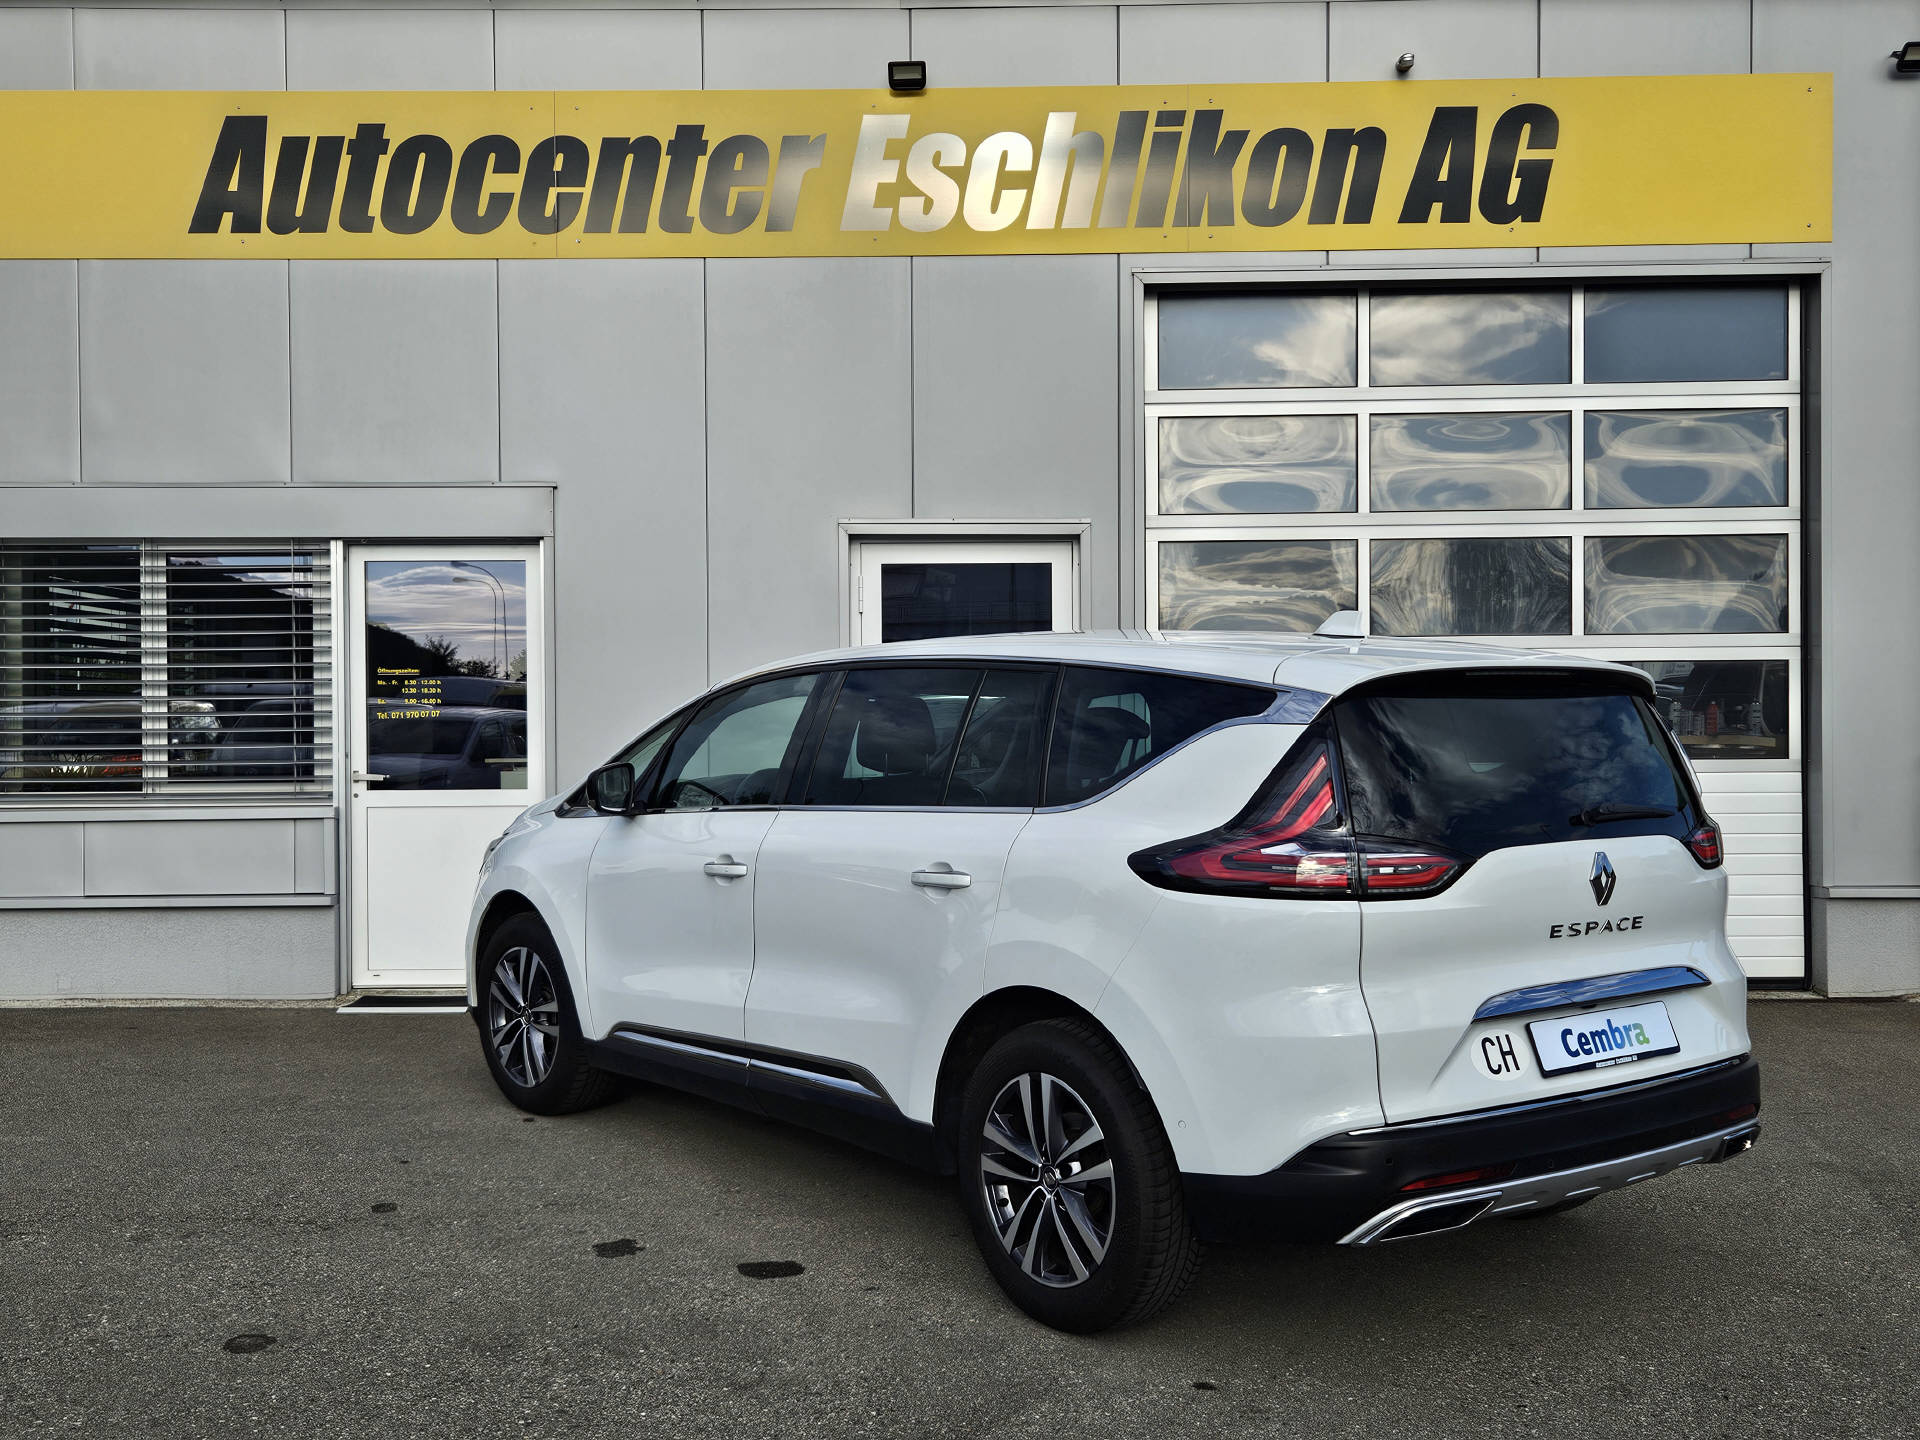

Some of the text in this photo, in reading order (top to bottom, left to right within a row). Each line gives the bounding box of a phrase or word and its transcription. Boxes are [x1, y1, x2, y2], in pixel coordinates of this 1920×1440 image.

[188, 103, 1560, 236] Autocenter Eschlikon AG
[376, 712, 390, 720] Tel.
[391, 711, 404, 719] 071
[420, 710, 430, 718] 07
[431, 710, 440, 718] 07
[1549, 915, 1645, 939] ESPACE
[1480, 1033, 1521, 1075] CH
[1560, 1018, 1651, 1059] Cembra
